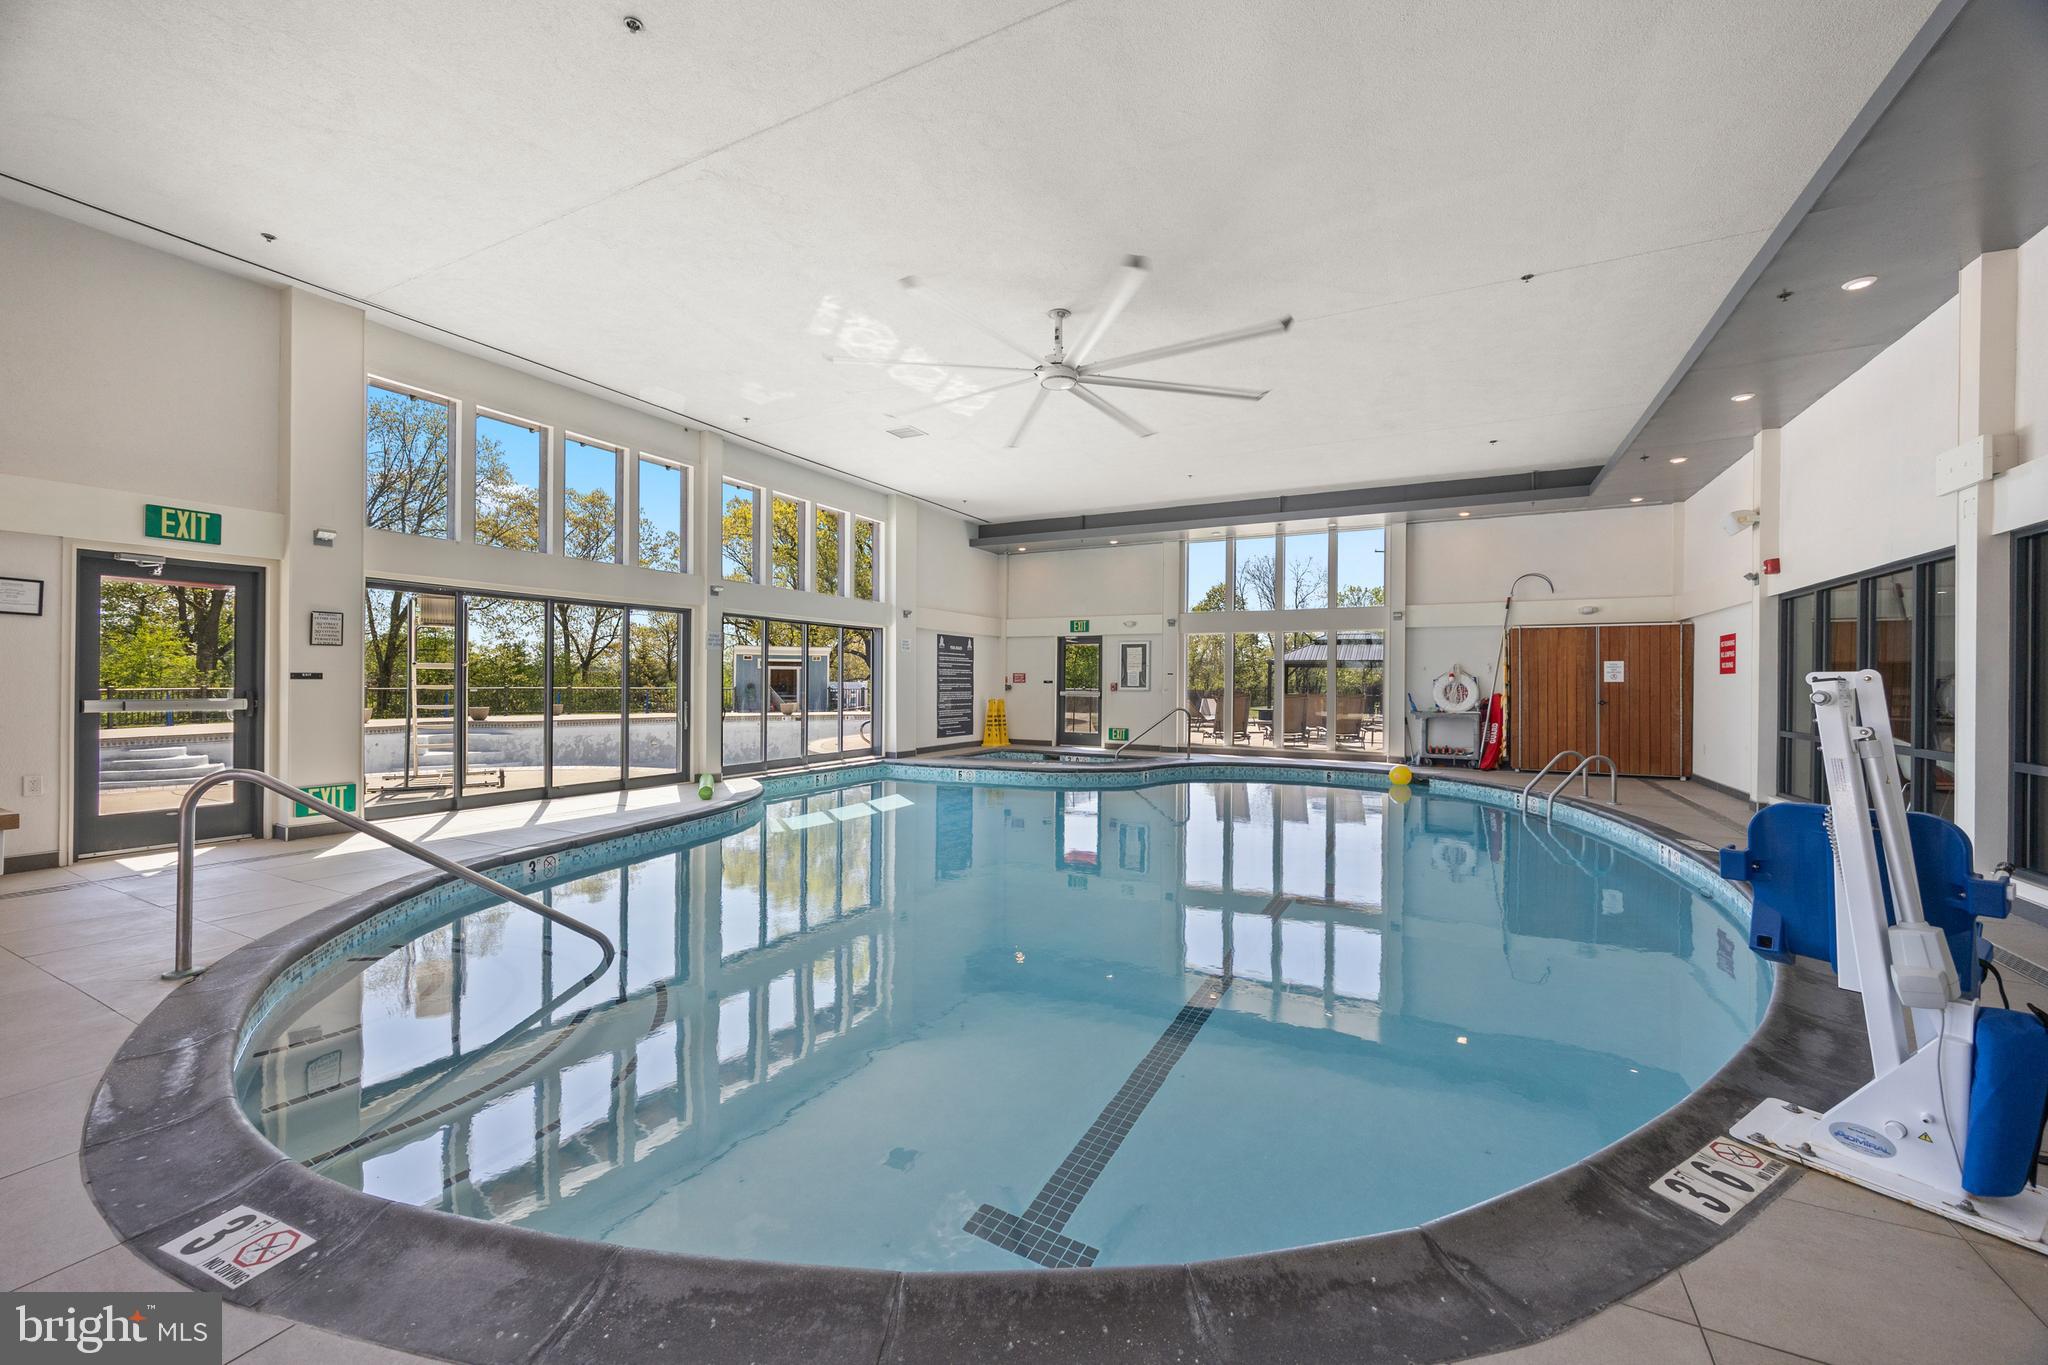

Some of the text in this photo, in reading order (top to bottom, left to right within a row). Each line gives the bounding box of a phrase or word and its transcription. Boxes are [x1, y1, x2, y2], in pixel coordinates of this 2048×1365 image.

[162, 507, 210, 541] EXIT
[1073, 621, 1086, 632] EXIT
[1112, 728, 1125, 739] EXIT
[1690, 1161, 1755, 1193] 6
[1664, 1178, 1731, 1213] 3
[180, 1214, 257, 1255] 3
[247, 1219, 272, 1234] FT
[203, 1256, 251, 1286] NO DIVING
